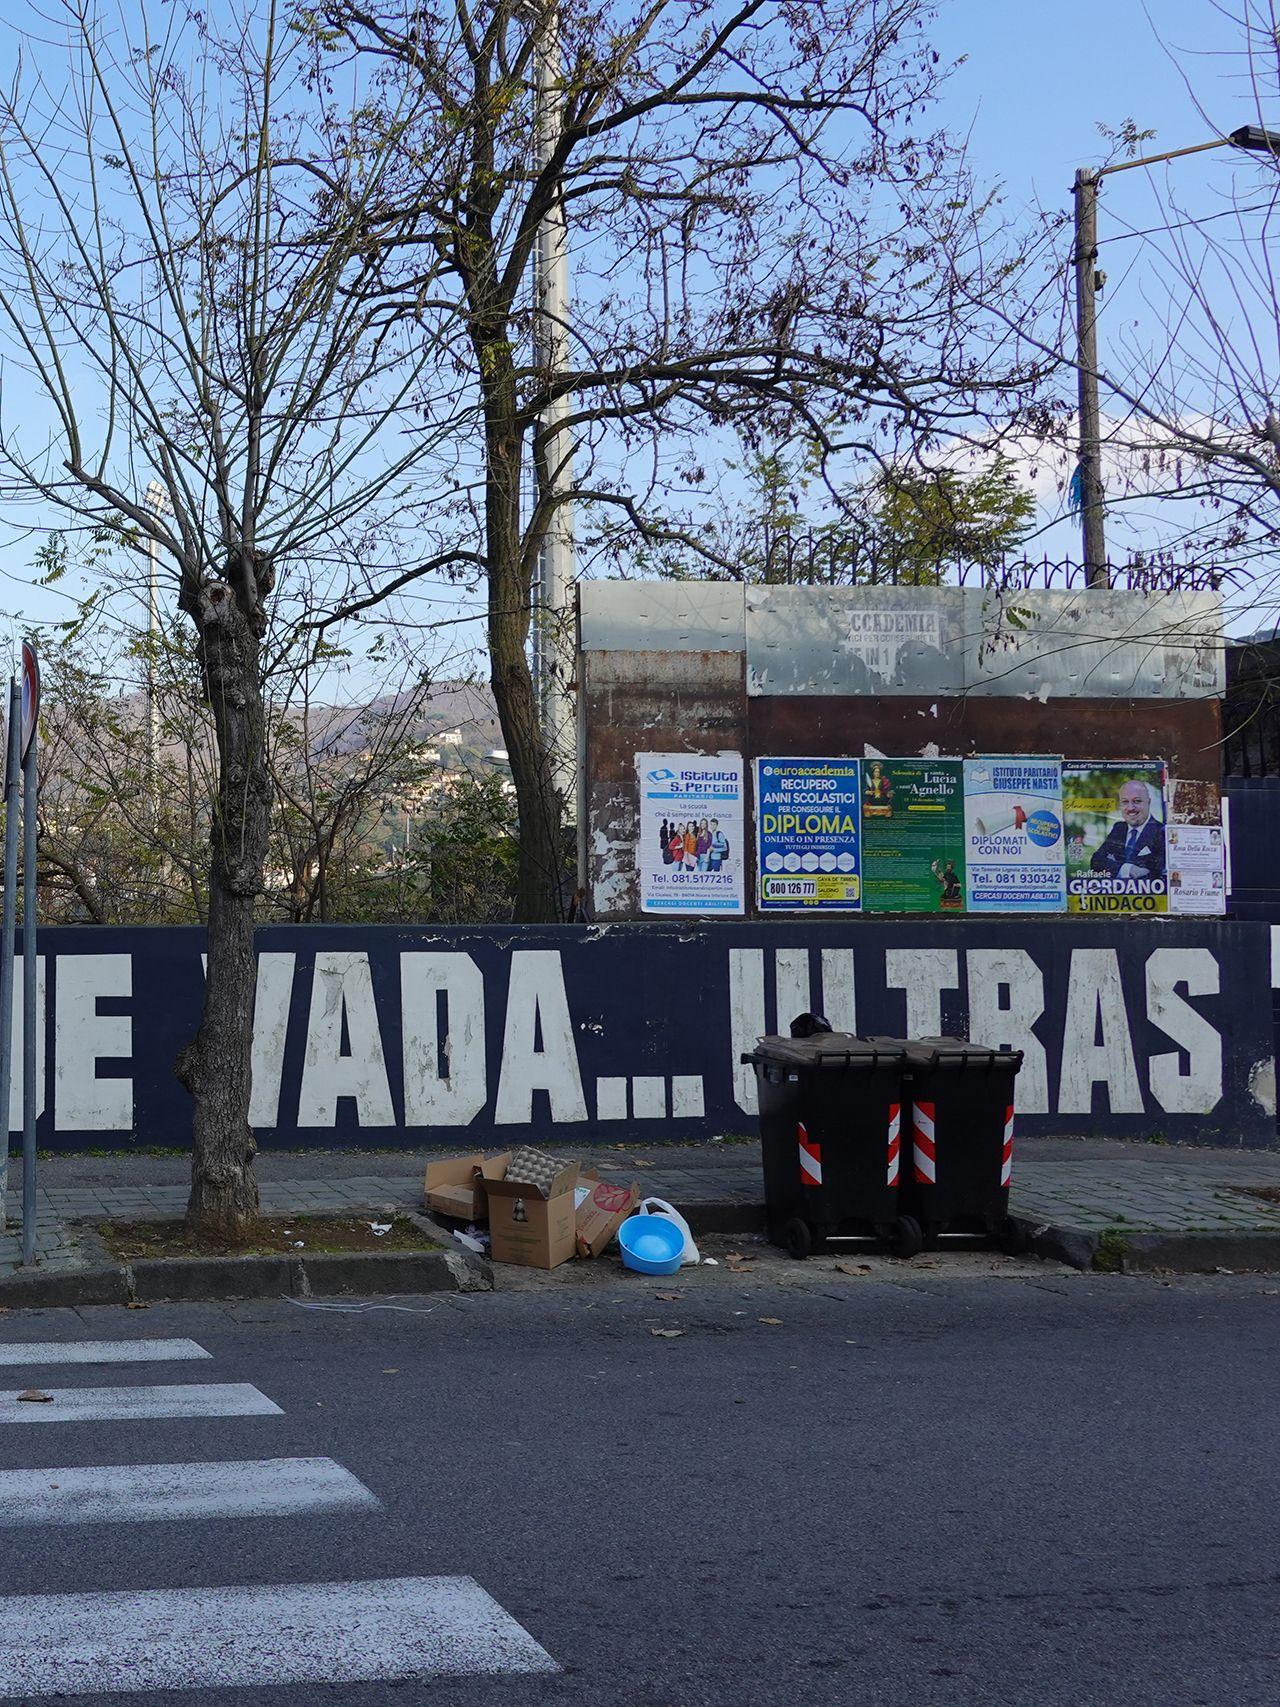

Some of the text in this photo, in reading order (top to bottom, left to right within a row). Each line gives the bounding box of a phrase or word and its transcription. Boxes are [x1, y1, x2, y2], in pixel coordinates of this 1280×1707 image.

[773, 764, 855, 776] euroaccademia
[992, 767, 1058, 778] ISTITUTO PARITARIO
[923, 772, 957, 784] Lucia
[670, 781, 738, 793] S. Pertini
[781, 779, 838, 790] RECUPERO
[993, 778, 1059, 790] GIUSEPPE NASTA
[763, 792, 855, 804] ANNI SCOLASTICI
[778, 805, 841, 813] PER CONSEGUIRE IL
[763, 814, 856, 834] DIPLOMA
[764, 835, 856, 843] ONLINE O IN PRESENZA
[971, 836, 1027, 845] DIPLOMATI
[978, 846, 1022, 855] CON NOI
[652, 873, 734, 884] Tel. 081.5177216
[972, 873, 1061, 884] Tel. 081 930342
[1076, 869, 1112, 878] Raffaele
[770, 882, 786, 894] 800
[787, 882, 801, 894] 126
[802, 882, 815, 894] 777
[1069, 878, 1165, 895] GIORDANO
[1173, 888, 1199, 896] Rosario
[974, 892, 1003, 900] CERCASI
[1003, 892, 1031, 900] DOCENTI
